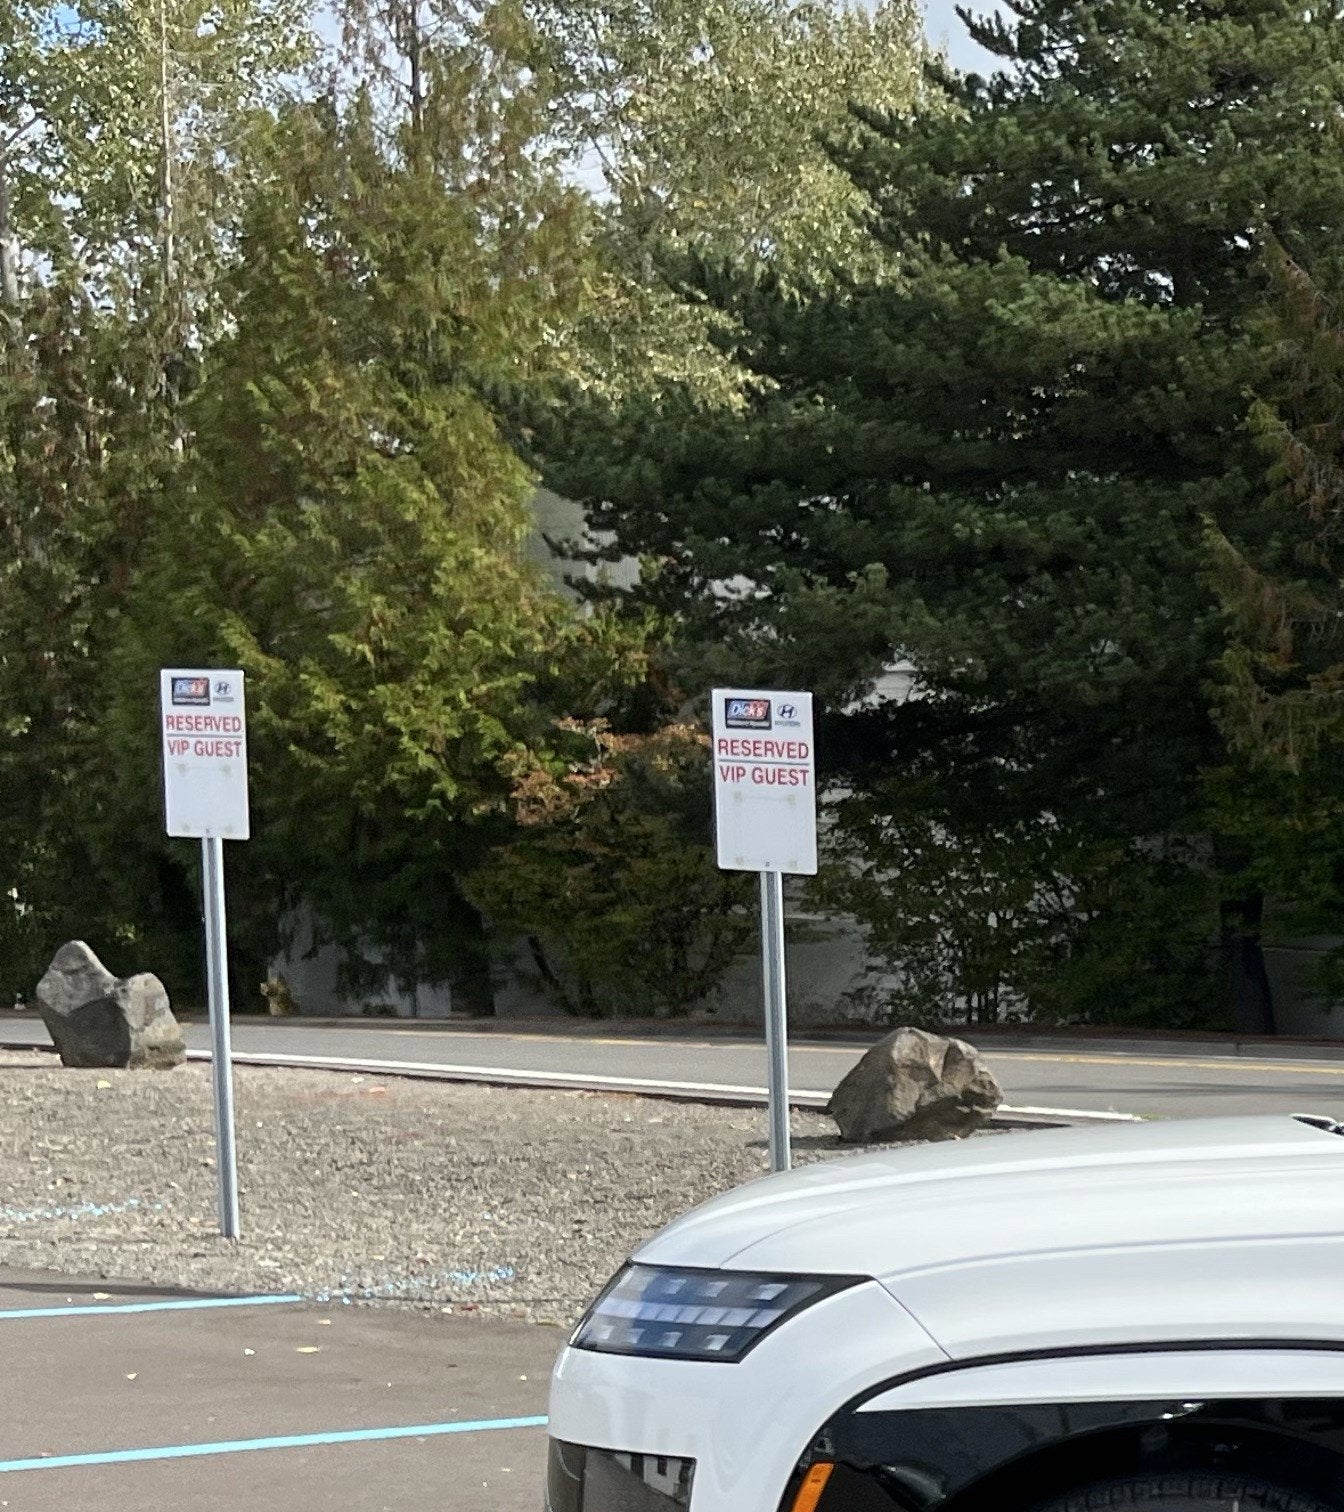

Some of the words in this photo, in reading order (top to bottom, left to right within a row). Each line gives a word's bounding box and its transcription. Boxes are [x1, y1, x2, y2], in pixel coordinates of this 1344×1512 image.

[166, 714, 242, 733] RESERVED
[168, 740, 189, 756] VIP
[194, 740, 241, 757] GUEST
[717, 738, 810, 760] RESERVED
[719, 765, 746, 784] VIP
[751, 767, 810, 787] GUEST
